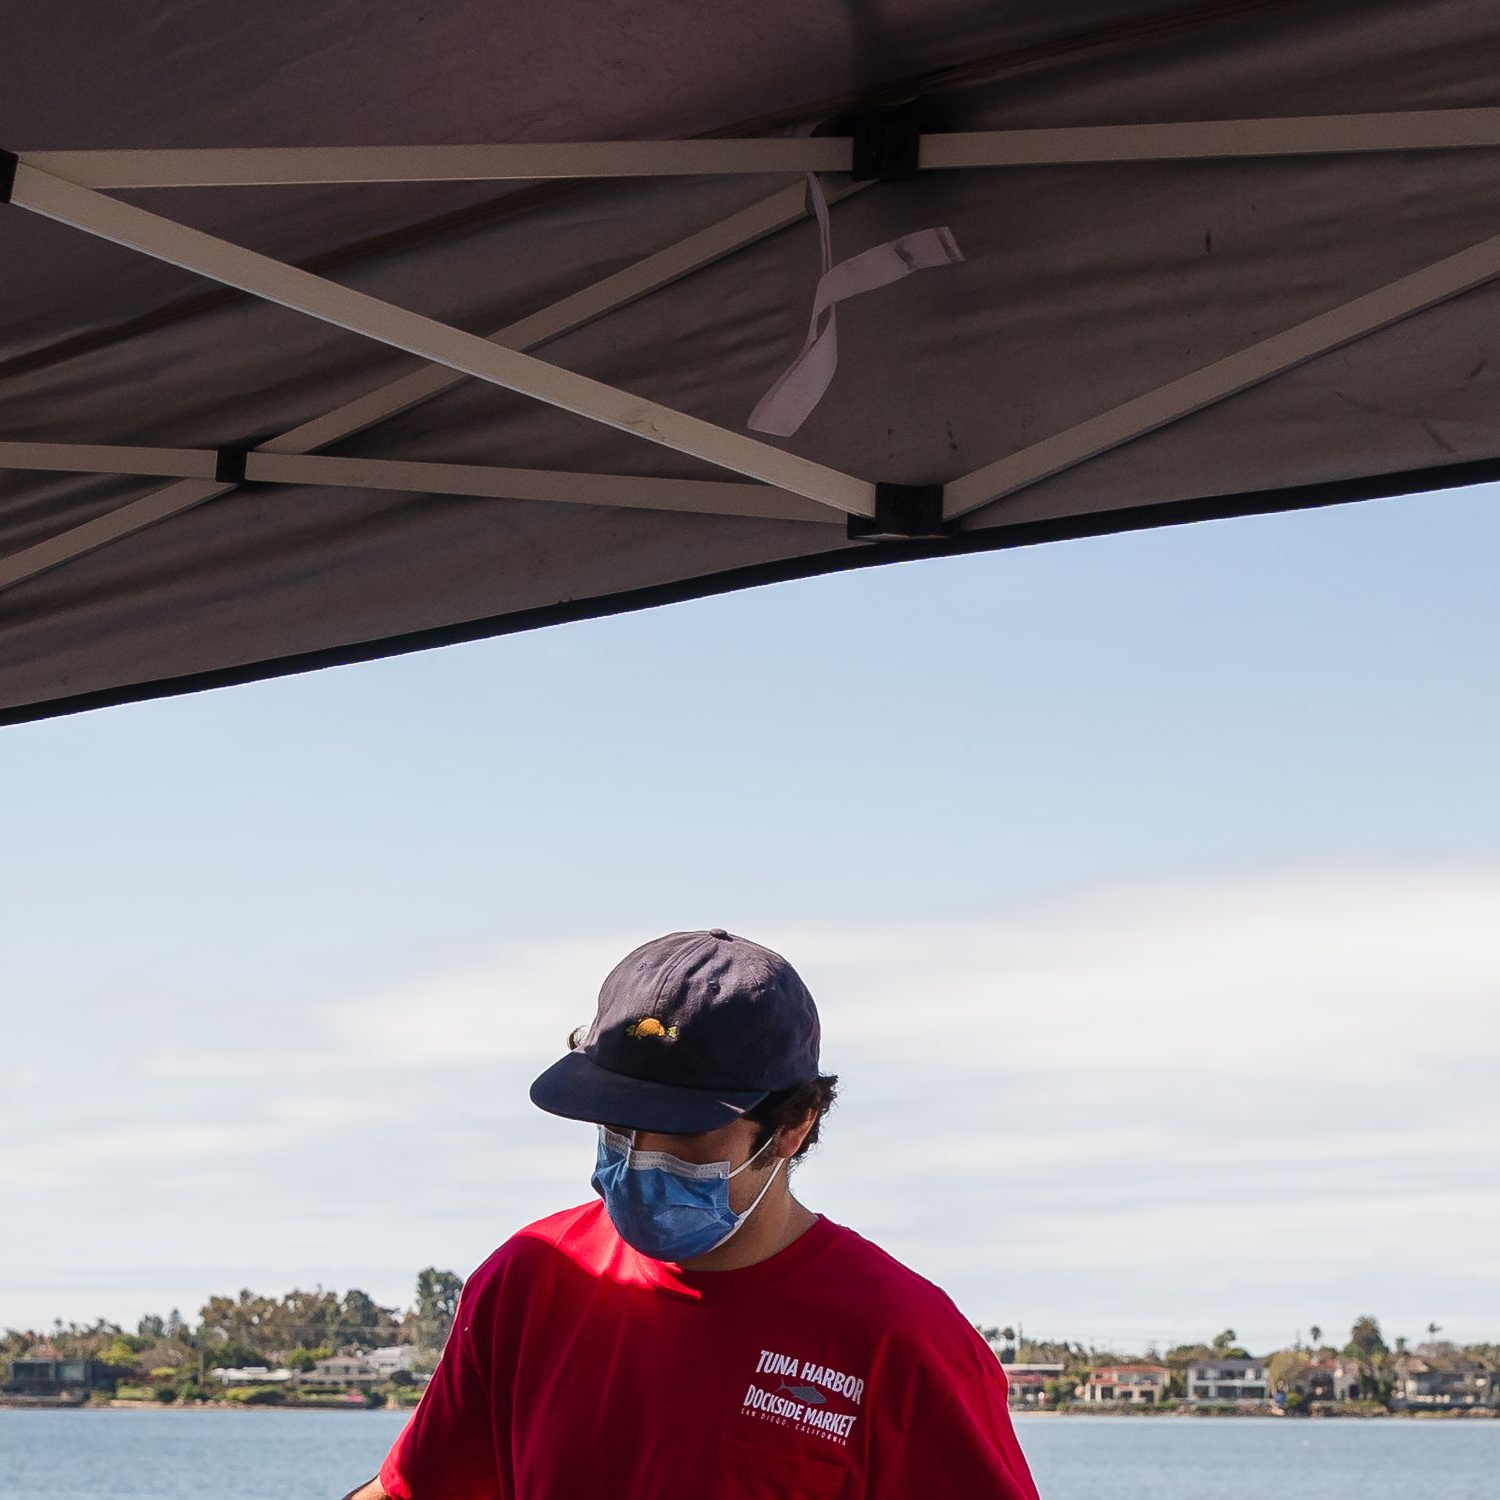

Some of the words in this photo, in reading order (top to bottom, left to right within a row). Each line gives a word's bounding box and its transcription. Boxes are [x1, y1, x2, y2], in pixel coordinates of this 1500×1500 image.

[755, 1349, 799, 1377] TUNA
[800, 1361, 864, 1405] HARBOR
[740, 1408, 756, 1418] SAN
[795, 1423, 847, 1446] CALIFORNIA
[743, 1384, 804, 1421] DOCKSIDE
[803, 1407, 857, 1438] MARKET
